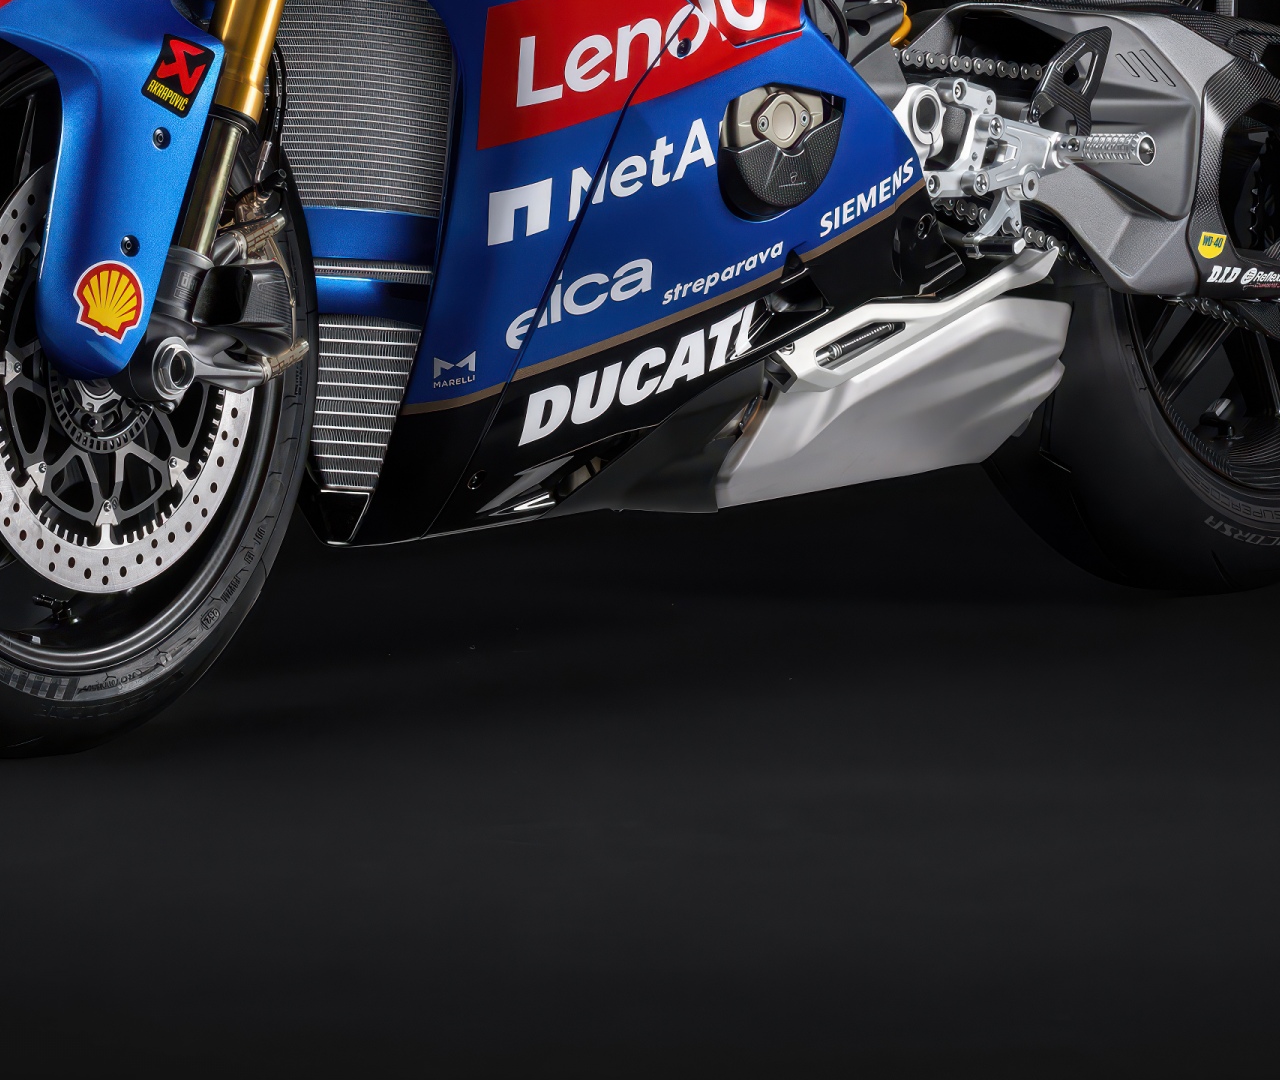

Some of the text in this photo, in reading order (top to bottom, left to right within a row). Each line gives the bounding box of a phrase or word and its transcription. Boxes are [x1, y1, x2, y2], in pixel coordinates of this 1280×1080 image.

[568, 118, 718, 222] NetA
[820, 157, 914, 238] SIEMENS
[662, 240, 784, 306] streparava
[1202, 235, 1224, 248] WD-40
[433, 375, 476, 389] MARELLI
[518, 301, 753, 447] DUCATI
